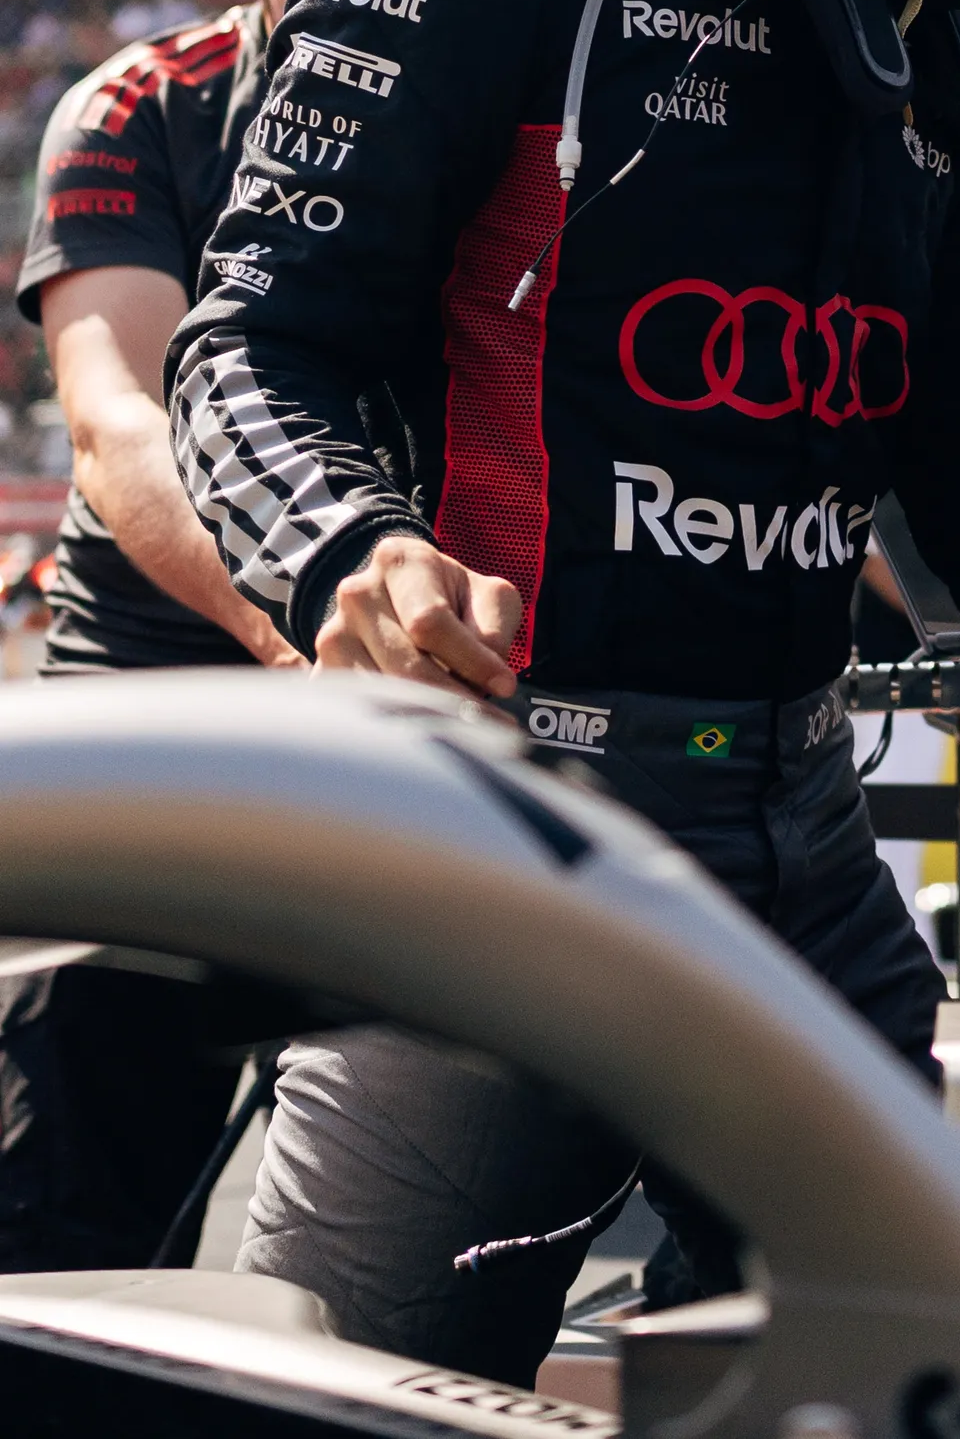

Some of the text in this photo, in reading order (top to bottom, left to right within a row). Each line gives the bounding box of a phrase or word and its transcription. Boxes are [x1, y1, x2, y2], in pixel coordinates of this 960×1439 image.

[622, 0, 772, 55] Revolut
[674, 72, 730, 103] visit
[268, 96, 363, 138] ORLD OF
[644, 92, 728, 127] QATAR
[252, 116, 355, 172] HYATT
[926, 140, 951, 178] bp
[225, 172, 345, 233] NEXO
[528, 706, 609, 745] OMP
